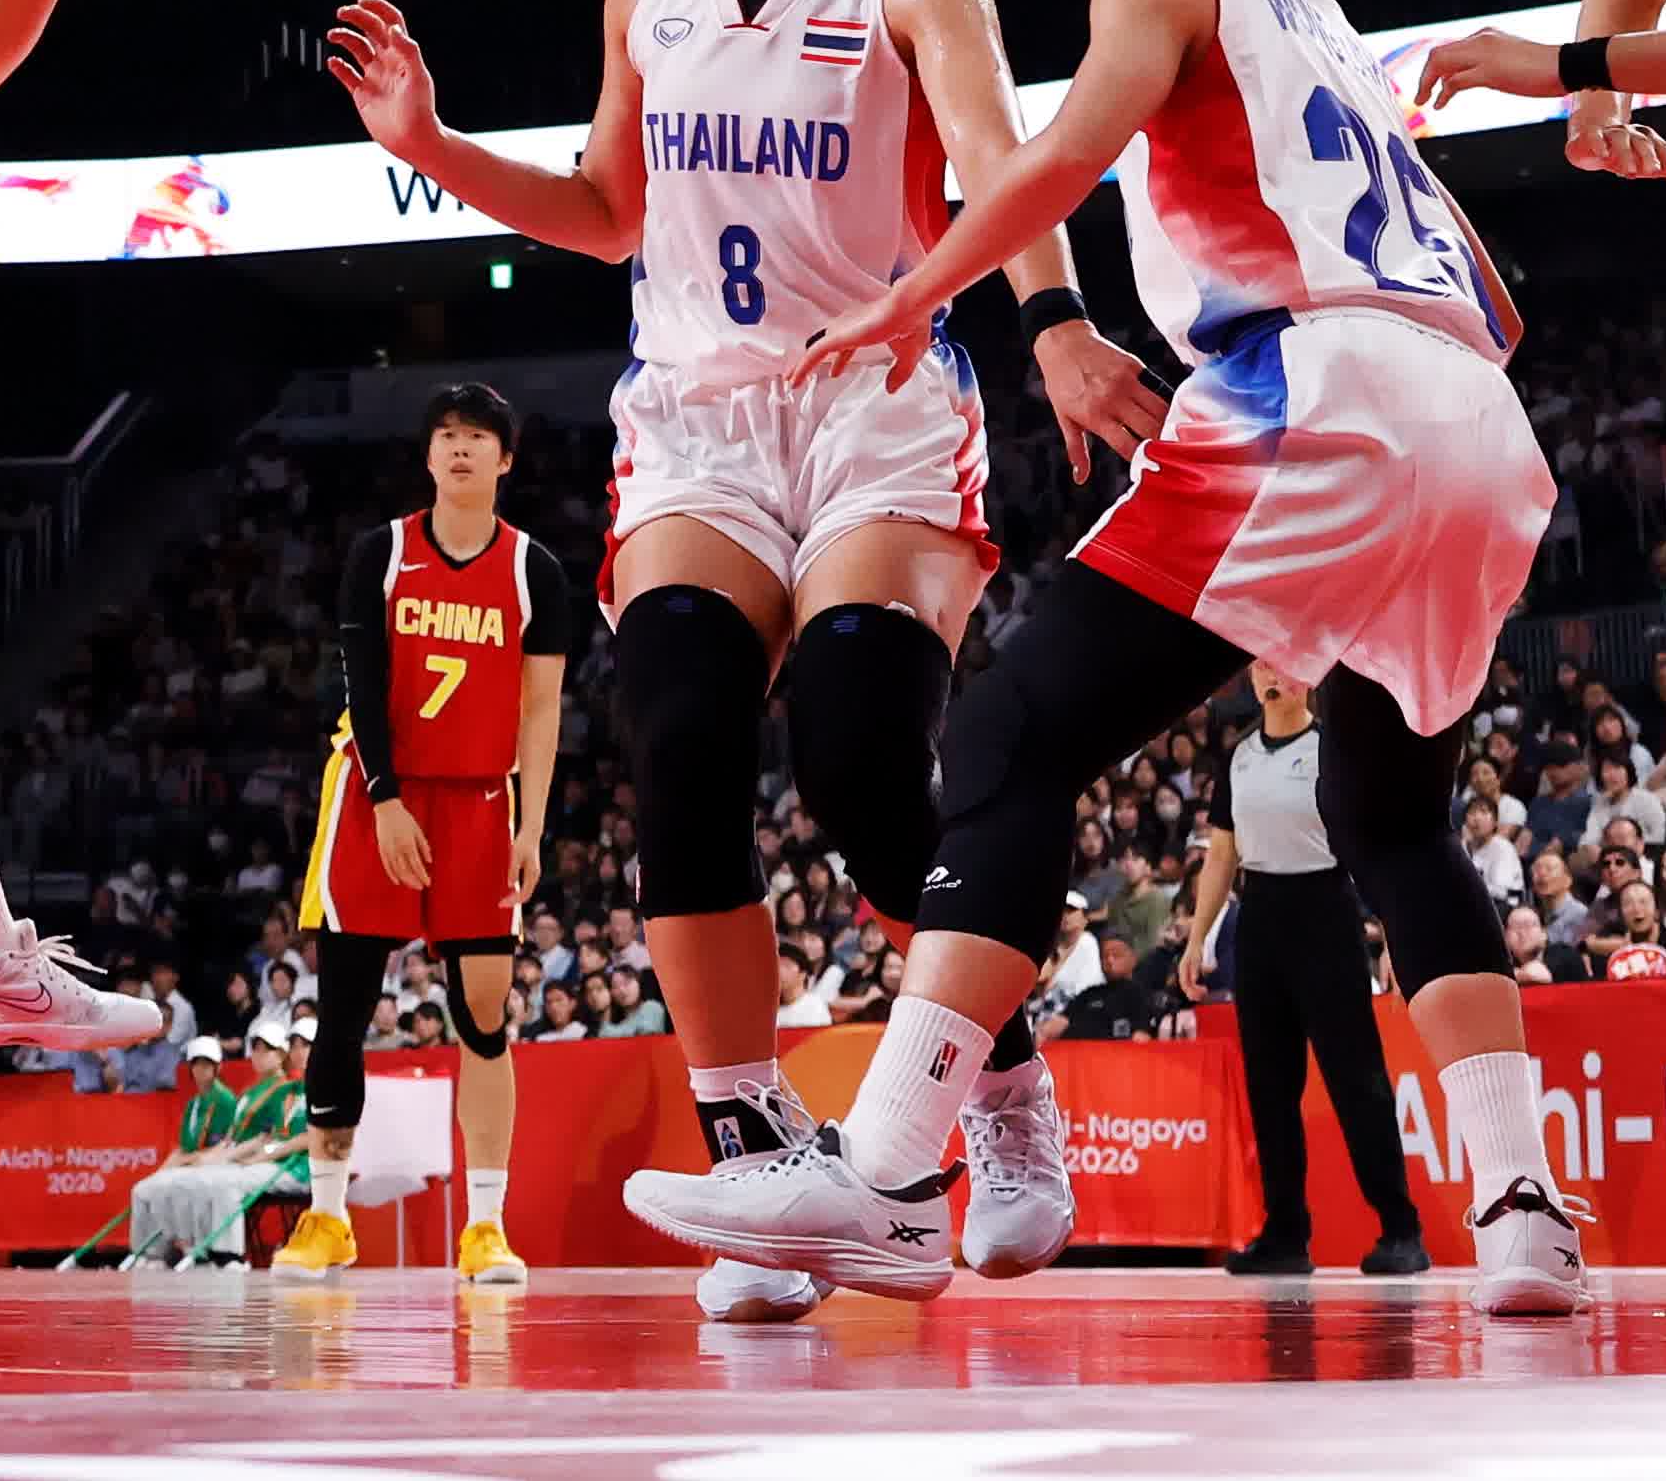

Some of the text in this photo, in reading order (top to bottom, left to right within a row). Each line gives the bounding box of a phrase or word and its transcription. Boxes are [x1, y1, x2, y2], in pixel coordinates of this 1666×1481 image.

[645, 110, 851, 183] THAILAND
[719, 224, 767, 327] 8
[395, 595, 505, 649] CHINA
[419, 653, 467, 720] 7
[1064, 1113, 1209, 1150] i-Nagoya
[1064, 1146, 1140, 1175] 2026
